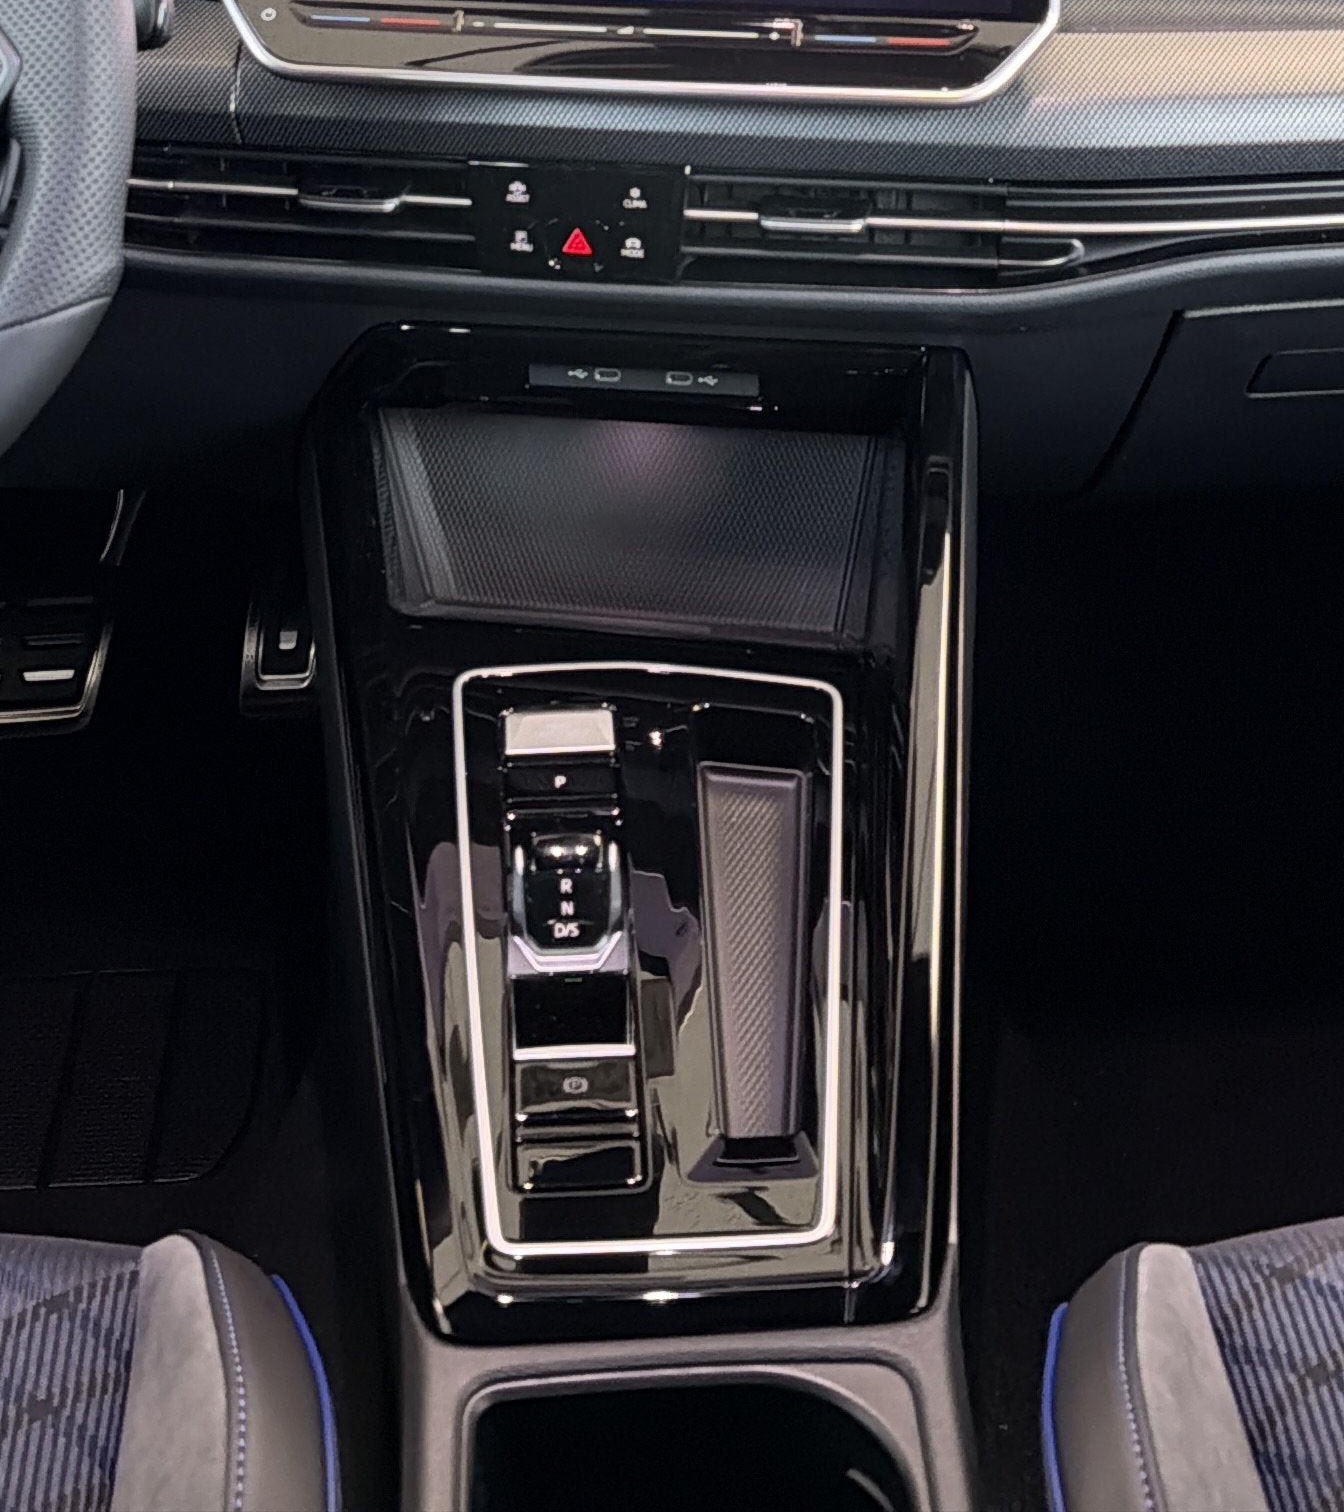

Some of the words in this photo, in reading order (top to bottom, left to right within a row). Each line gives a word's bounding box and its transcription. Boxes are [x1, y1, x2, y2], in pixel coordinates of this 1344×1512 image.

[554, 775, 567, 788] P
[560, 878, 573, 894] R
[560, 900, 575, 916] N
[553, 922, 581, 939] D/S
